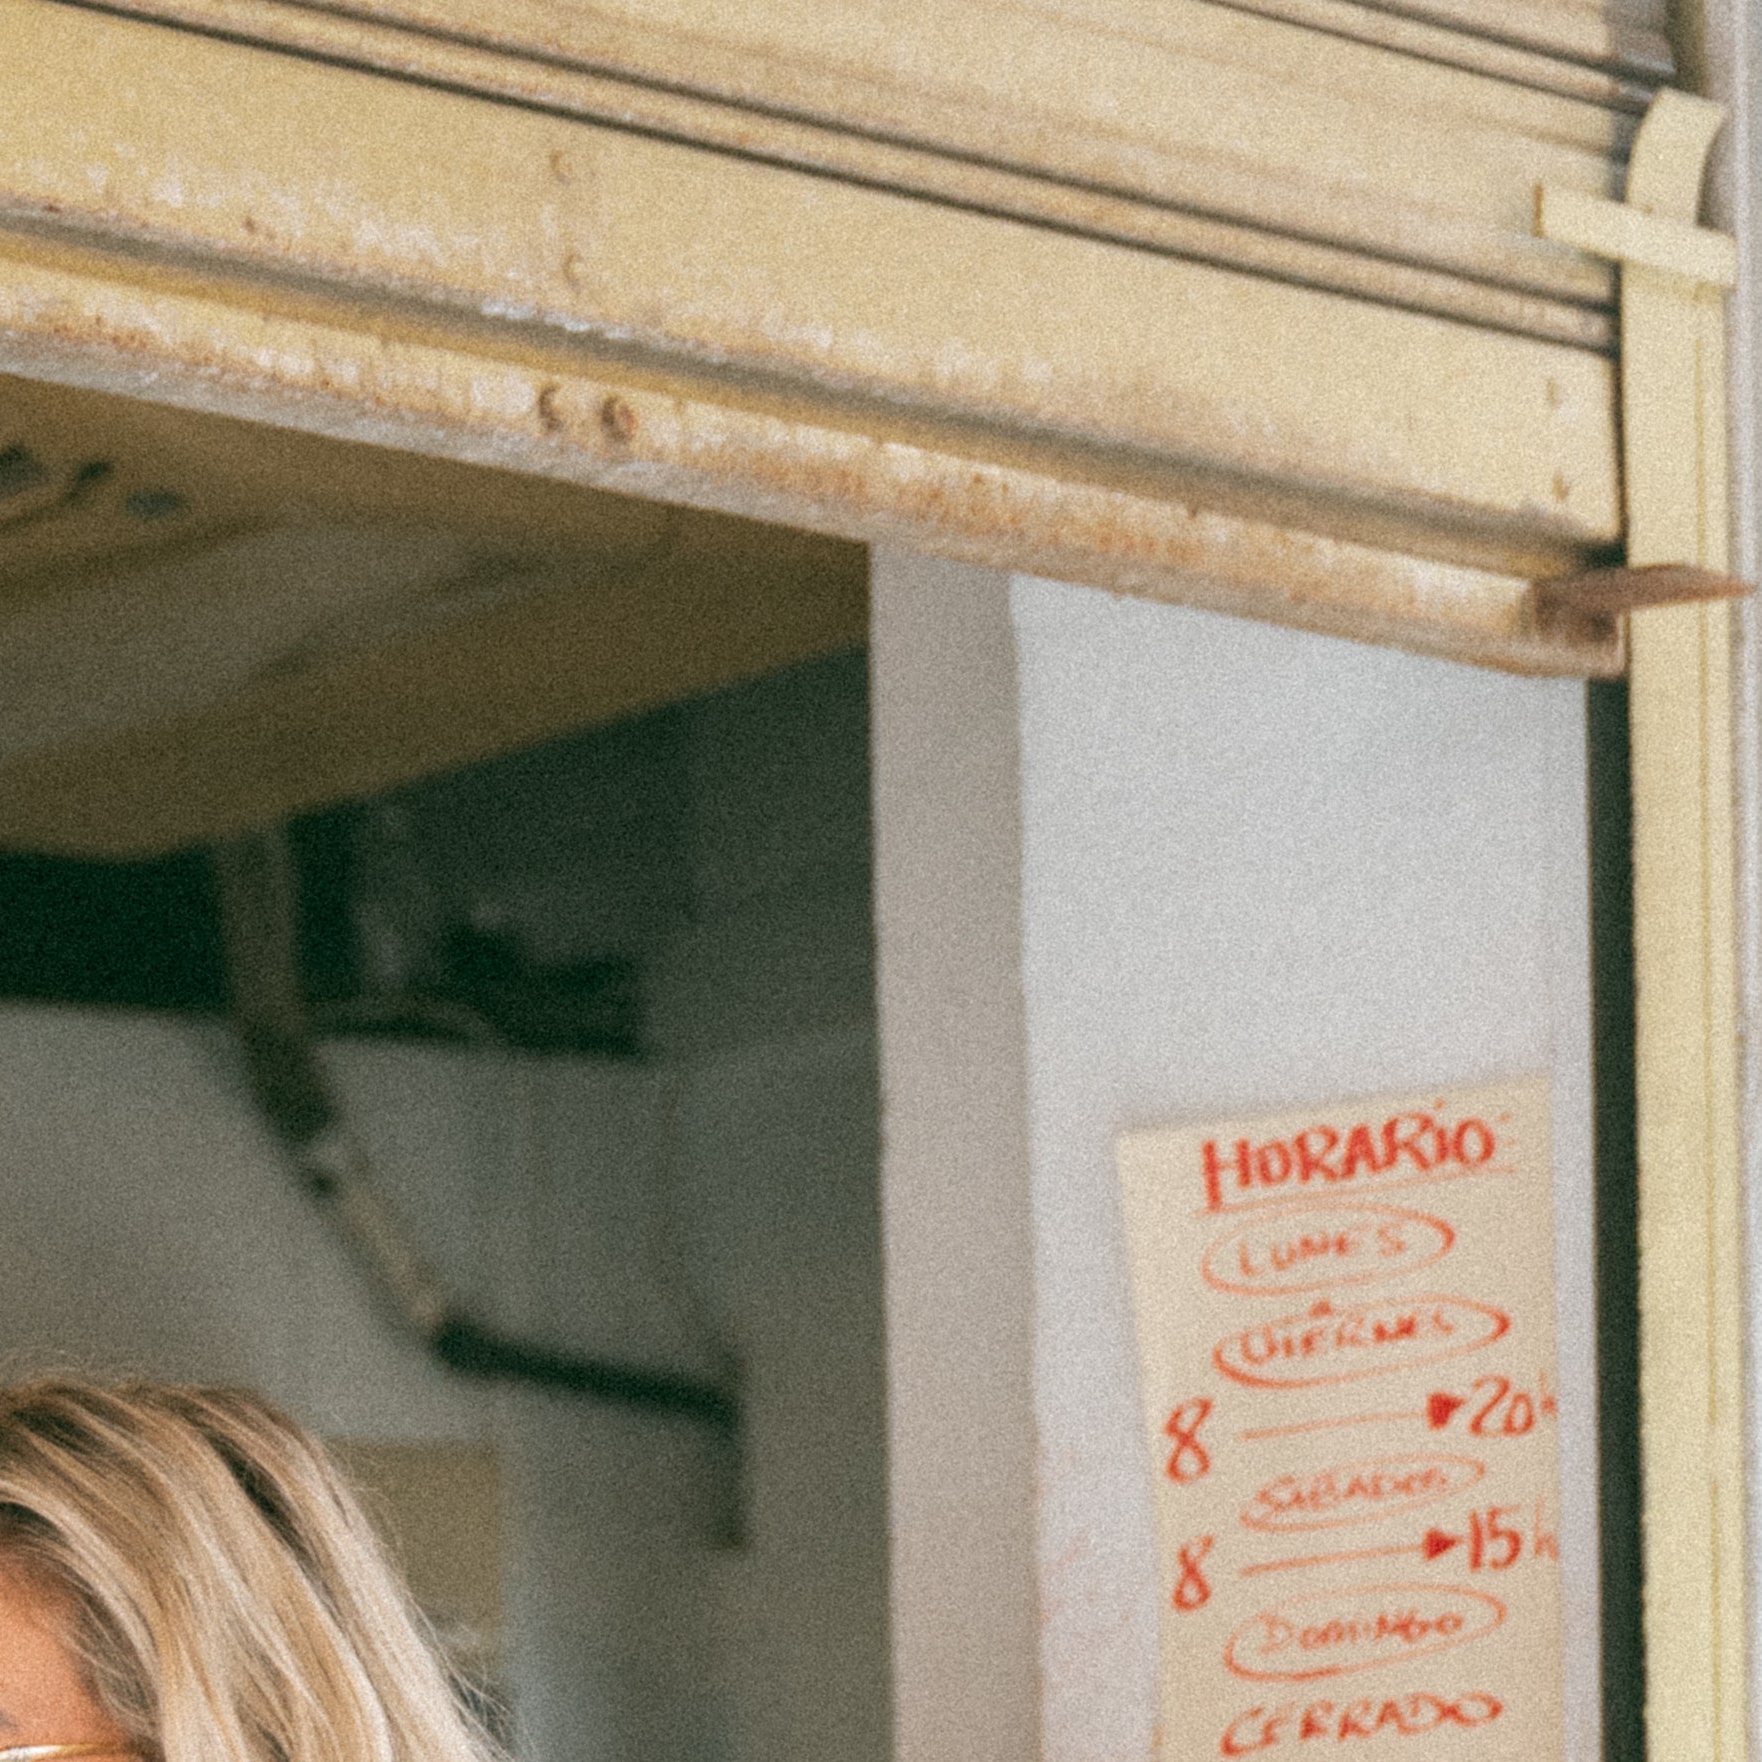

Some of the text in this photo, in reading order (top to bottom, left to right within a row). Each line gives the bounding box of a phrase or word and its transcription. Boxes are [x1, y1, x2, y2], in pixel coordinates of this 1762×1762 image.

[1163, 1398, 1214, 1484] 8
[1171, 1534, 1215, 1613] 8
[1220, 1691, 1503, 1758] CERRADO
